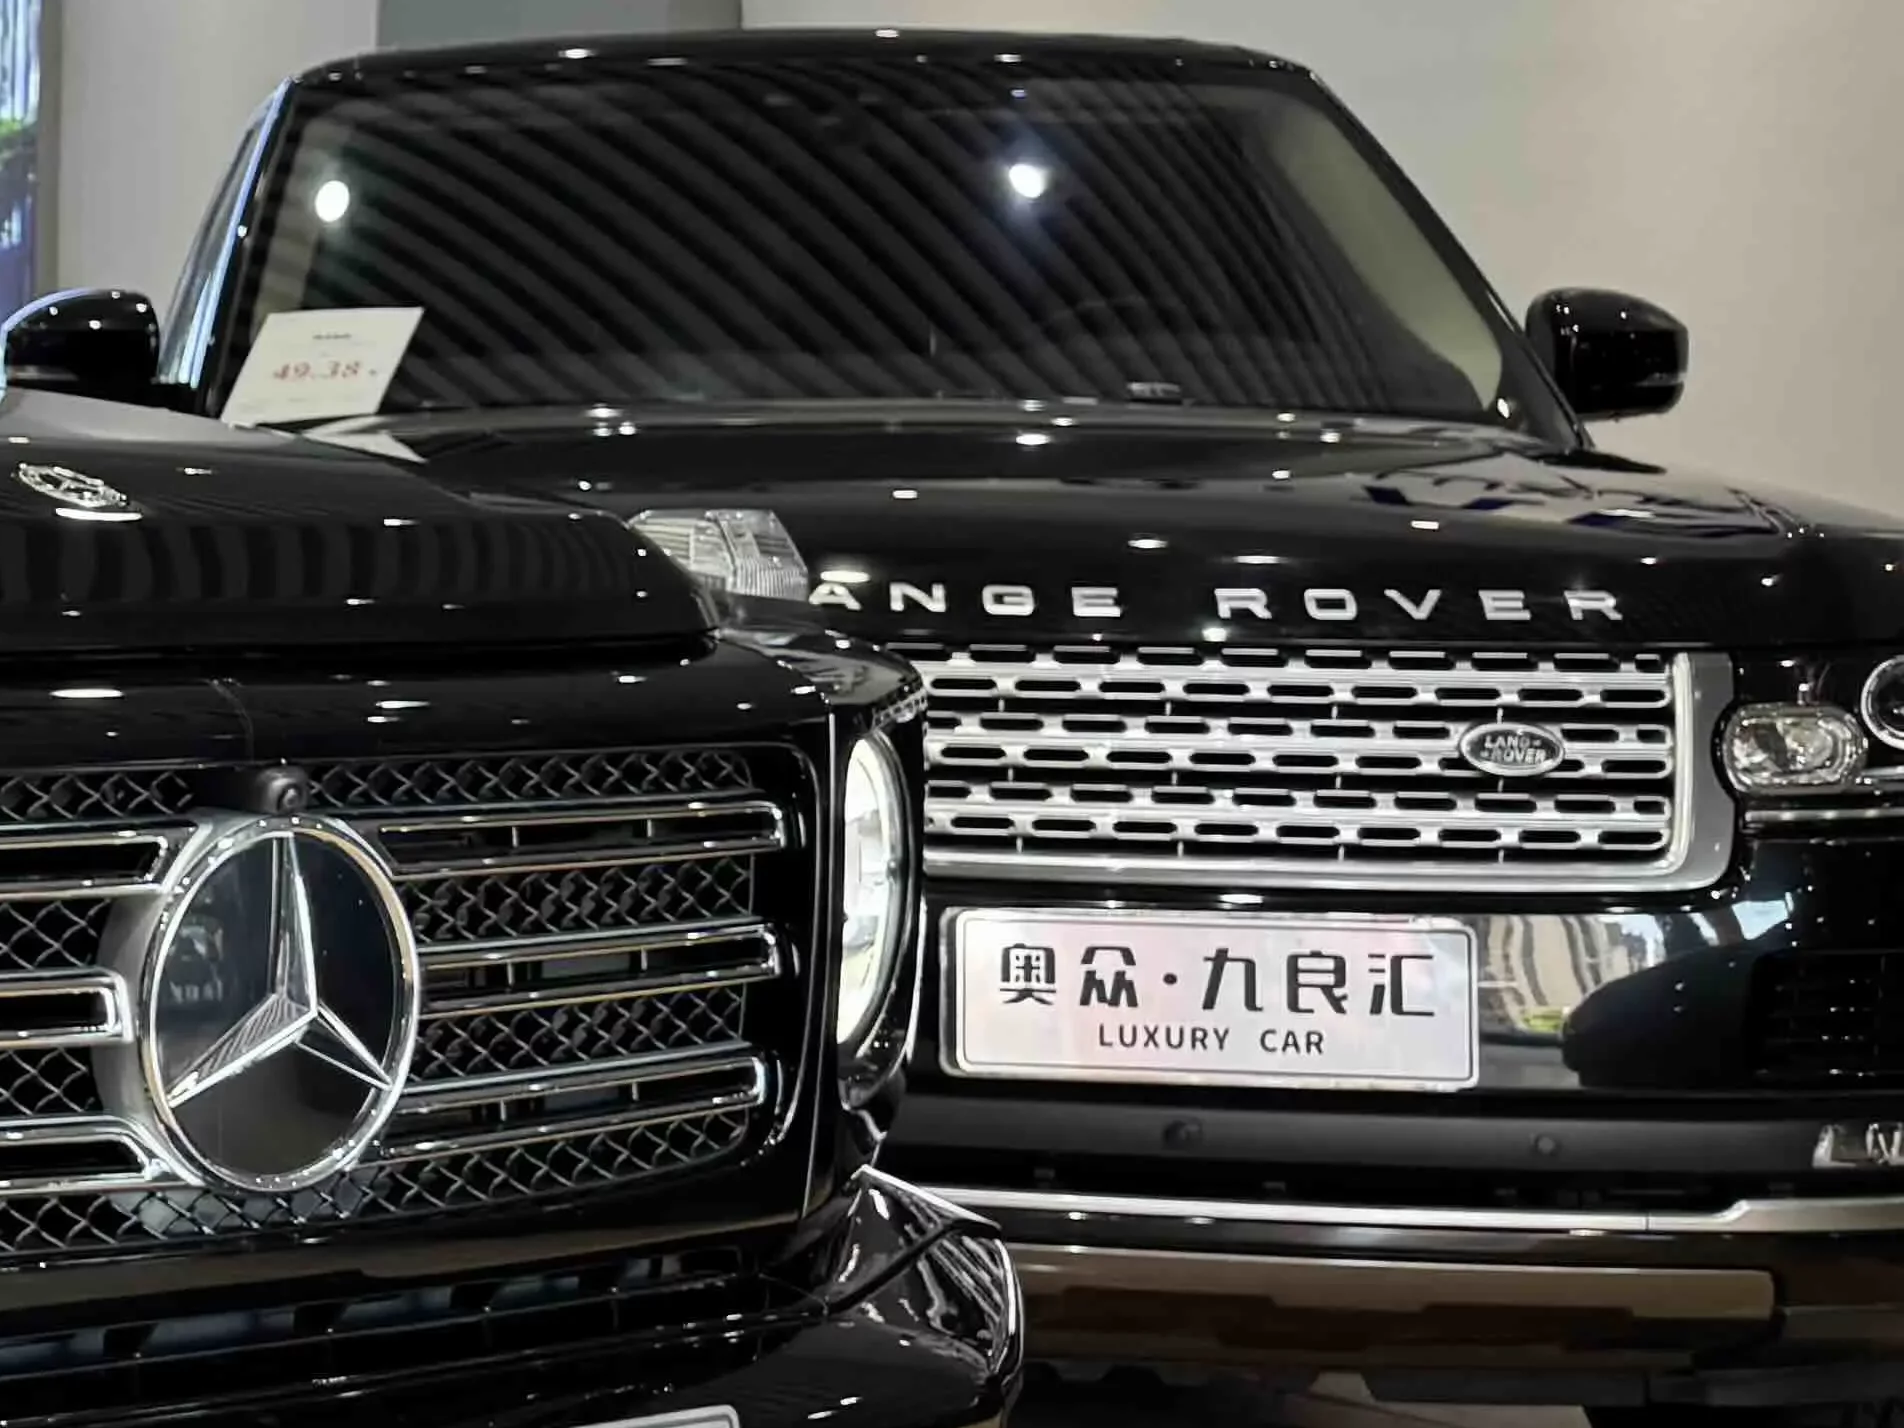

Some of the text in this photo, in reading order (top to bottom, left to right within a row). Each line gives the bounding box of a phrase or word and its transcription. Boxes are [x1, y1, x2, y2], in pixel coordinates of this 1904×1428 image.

[809, 582, 1623, 620] ANGE ROVER
[1484, 735, 1531, 749] LAND
[1490, 748, 1547, 764] ROVER
[1098, 1023, 1325, 1055] LUXURY CAR
